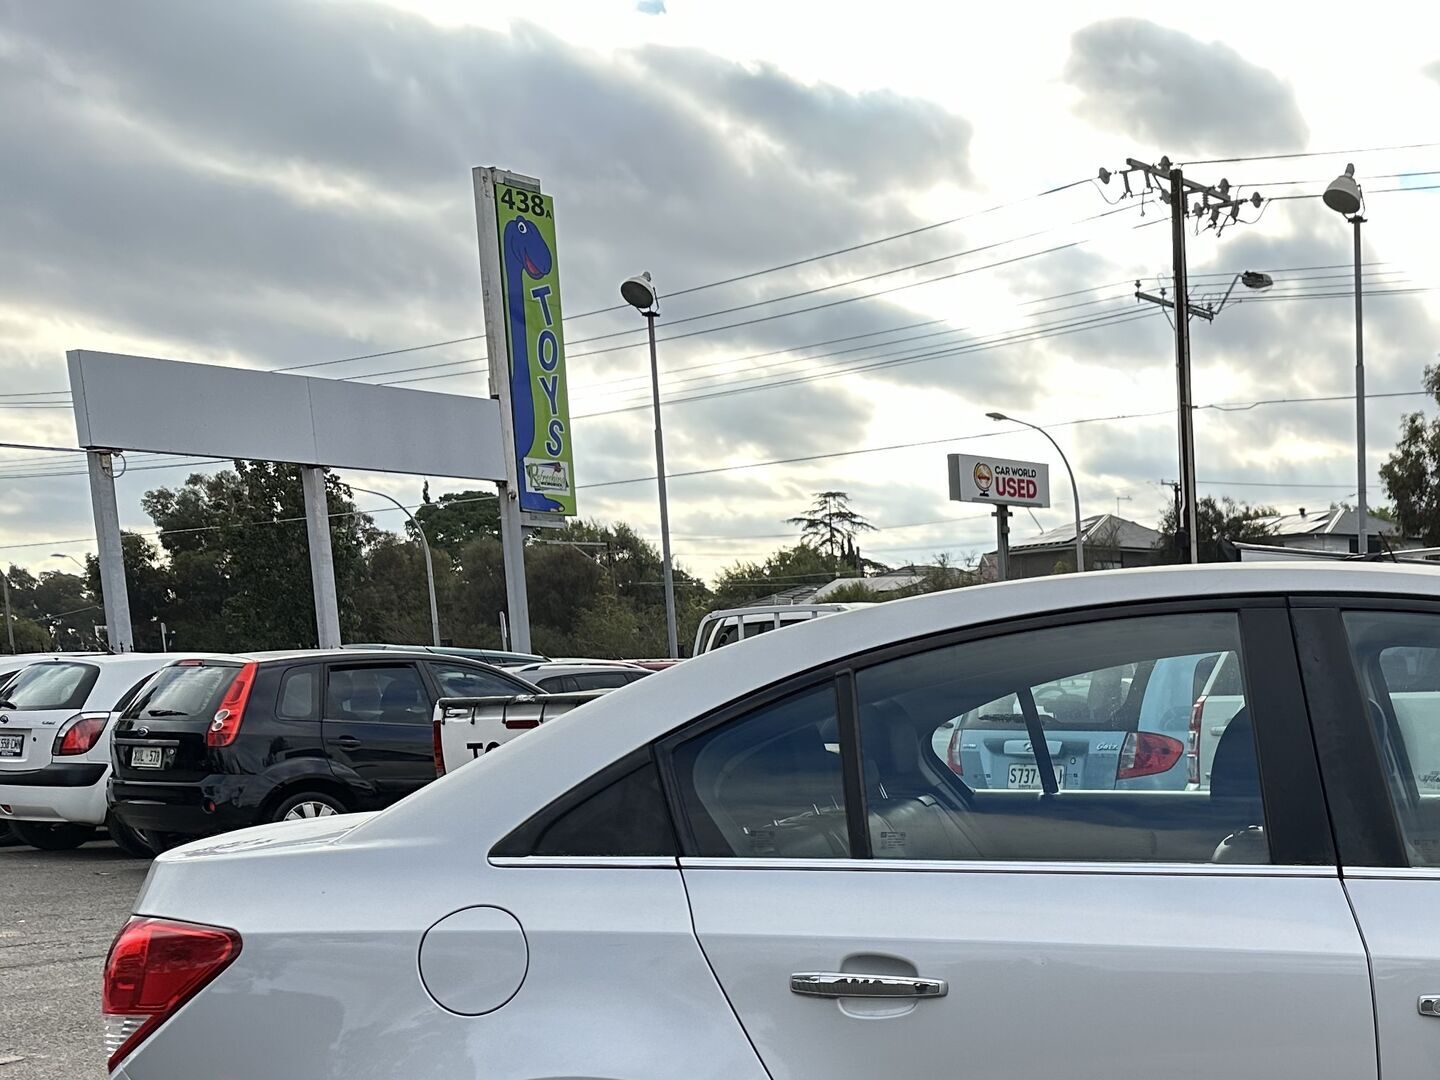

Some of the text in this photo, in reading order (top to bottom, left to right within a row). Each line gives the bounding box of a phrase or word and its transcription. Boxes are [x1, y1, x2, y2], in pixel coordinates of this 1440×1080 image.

[531, 285, 565, 458] TOYS
[994, 466, 1037, 478] CAR WORLD
[995, 476, 1038, 499] USED
